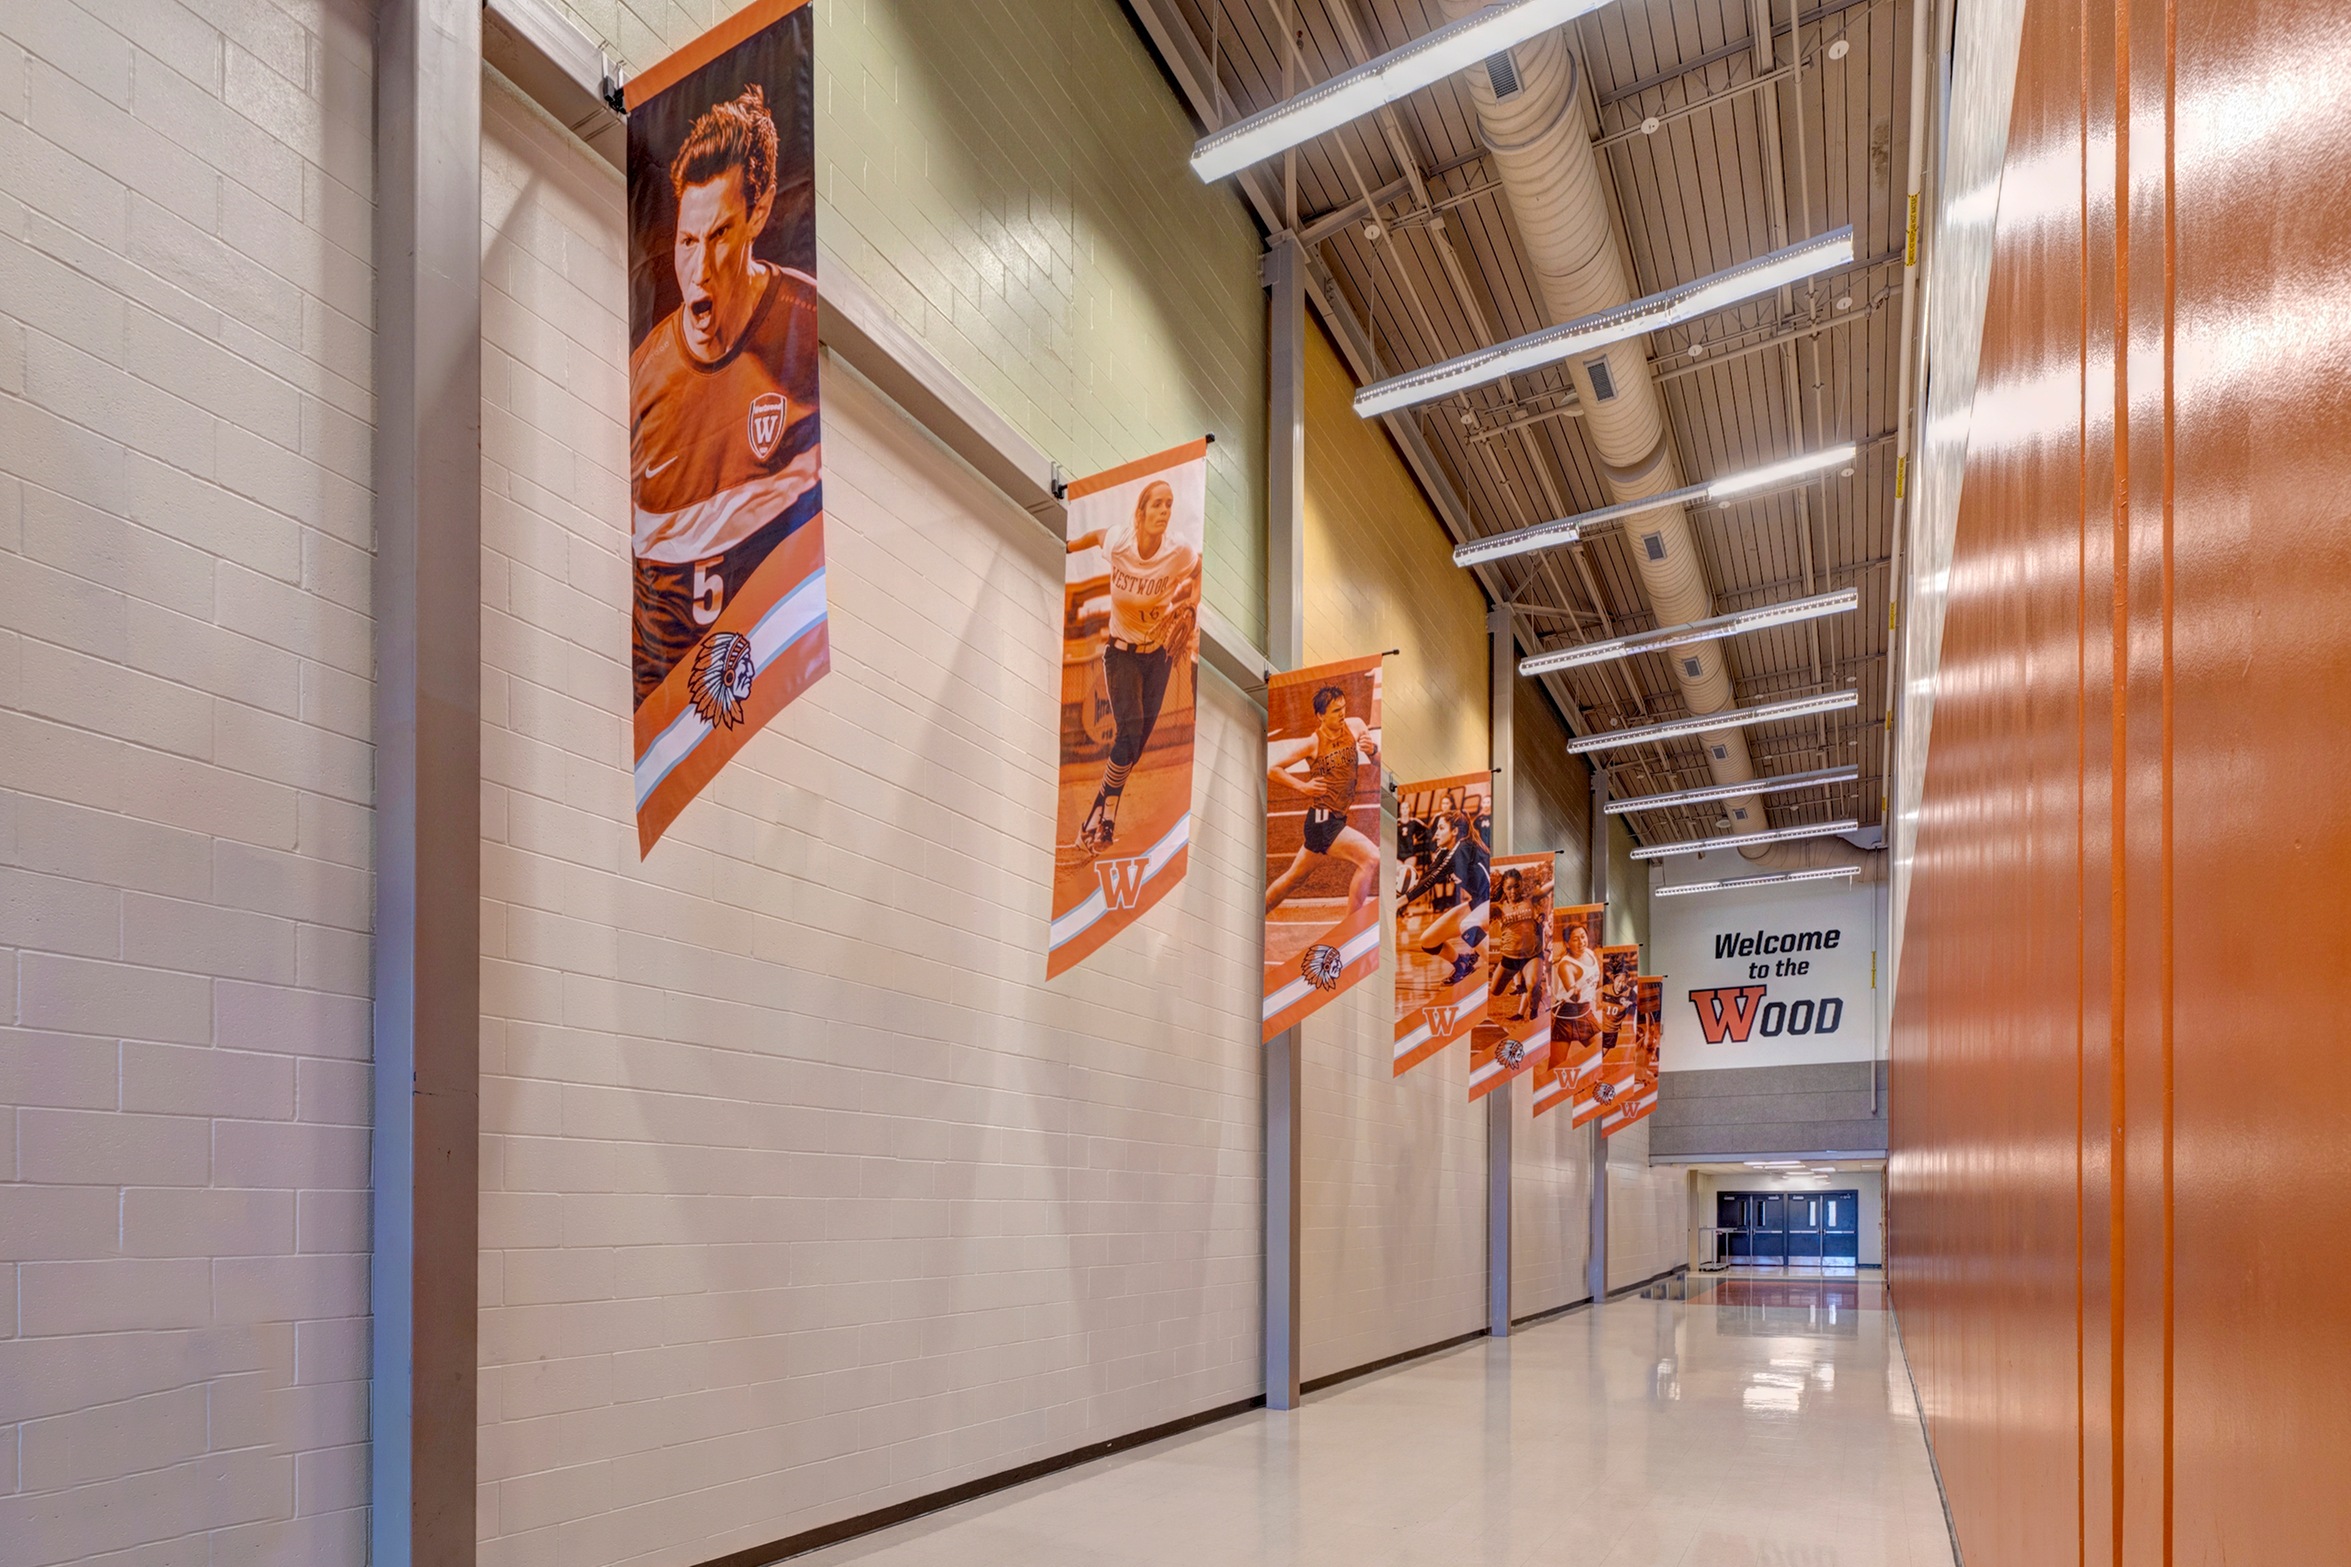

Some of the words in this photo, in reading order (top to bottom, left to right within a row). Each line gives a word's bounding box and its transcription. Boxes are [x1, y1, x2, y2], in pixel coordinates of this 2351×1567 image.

[754, 415, 778, 444] W
[692, 555, 724, 625] 5
[1138, 606, 1160, 623] 16
[1094, 855, 1152, 911] W
[1714, 929, 1841, 959] Welcome
[1749, 962, 1769, 979] to
[1775, 958, 1810, 977] the
[1422, 1005, 1459, 1037] W
[1606, 1006, 1619, 1016] 10
[1688, 984, 1844, 1045] WOOD
[1553, 1067, 1582, 1090] W
[1620, 1101, 1640, 1118] W
